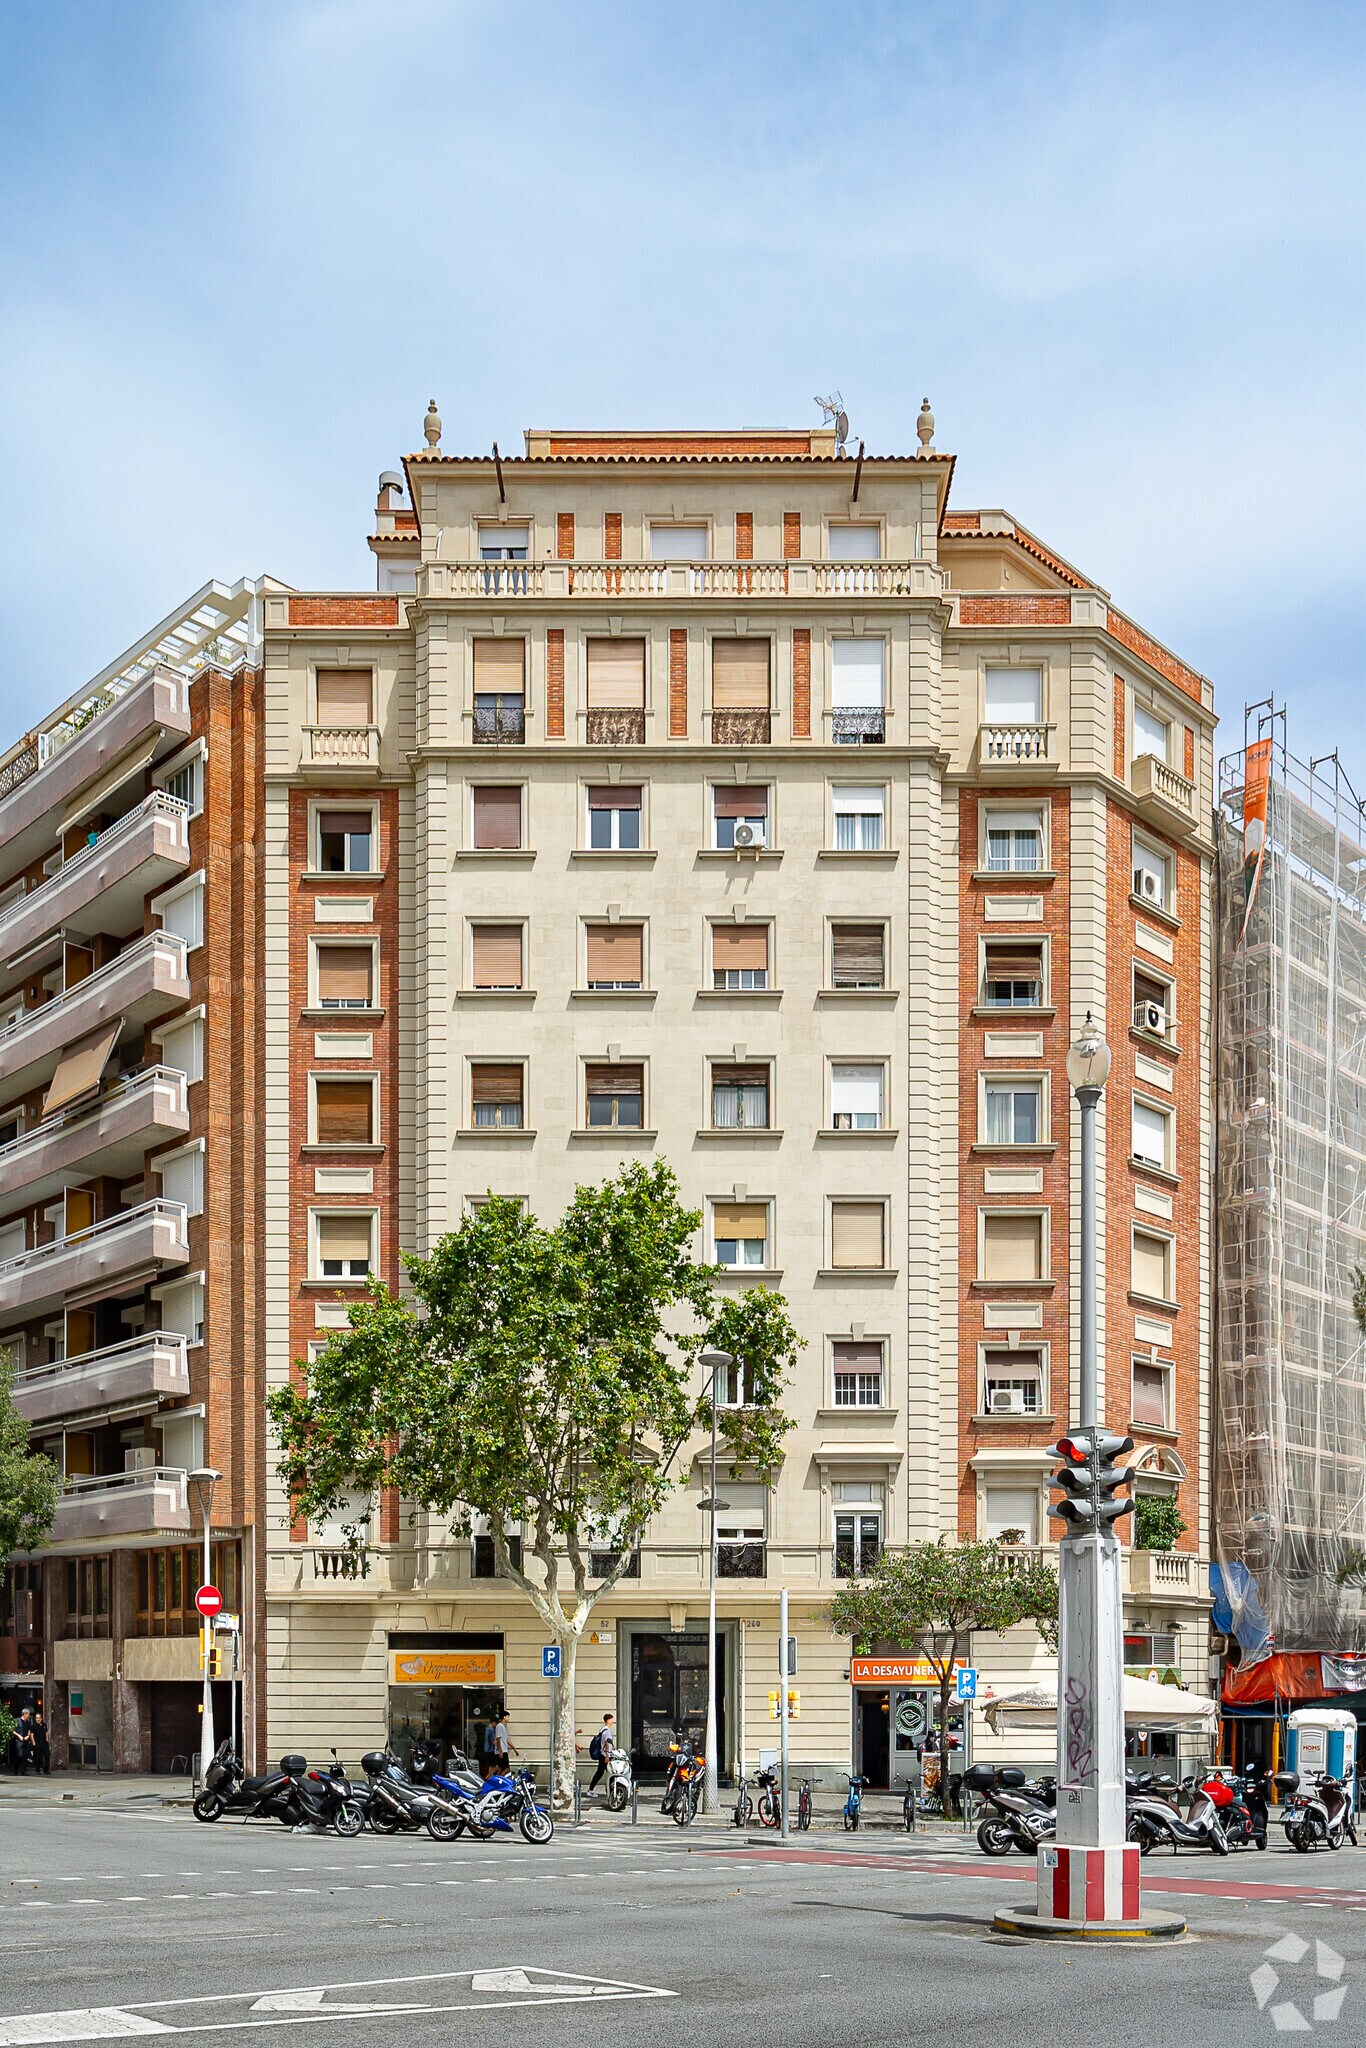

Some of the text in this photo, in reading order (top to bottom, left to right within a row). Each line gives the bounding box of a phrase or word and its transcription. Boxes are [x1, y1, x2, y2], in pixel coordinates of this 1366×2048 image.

[746, 1620, 761, 1628] 260
[547, 1650, 556, 1663] P
[423, 1659, 465, 1679] Organic
[857, 1666, 870, 1676] LA
[962, 1672, 972, 1685] P
